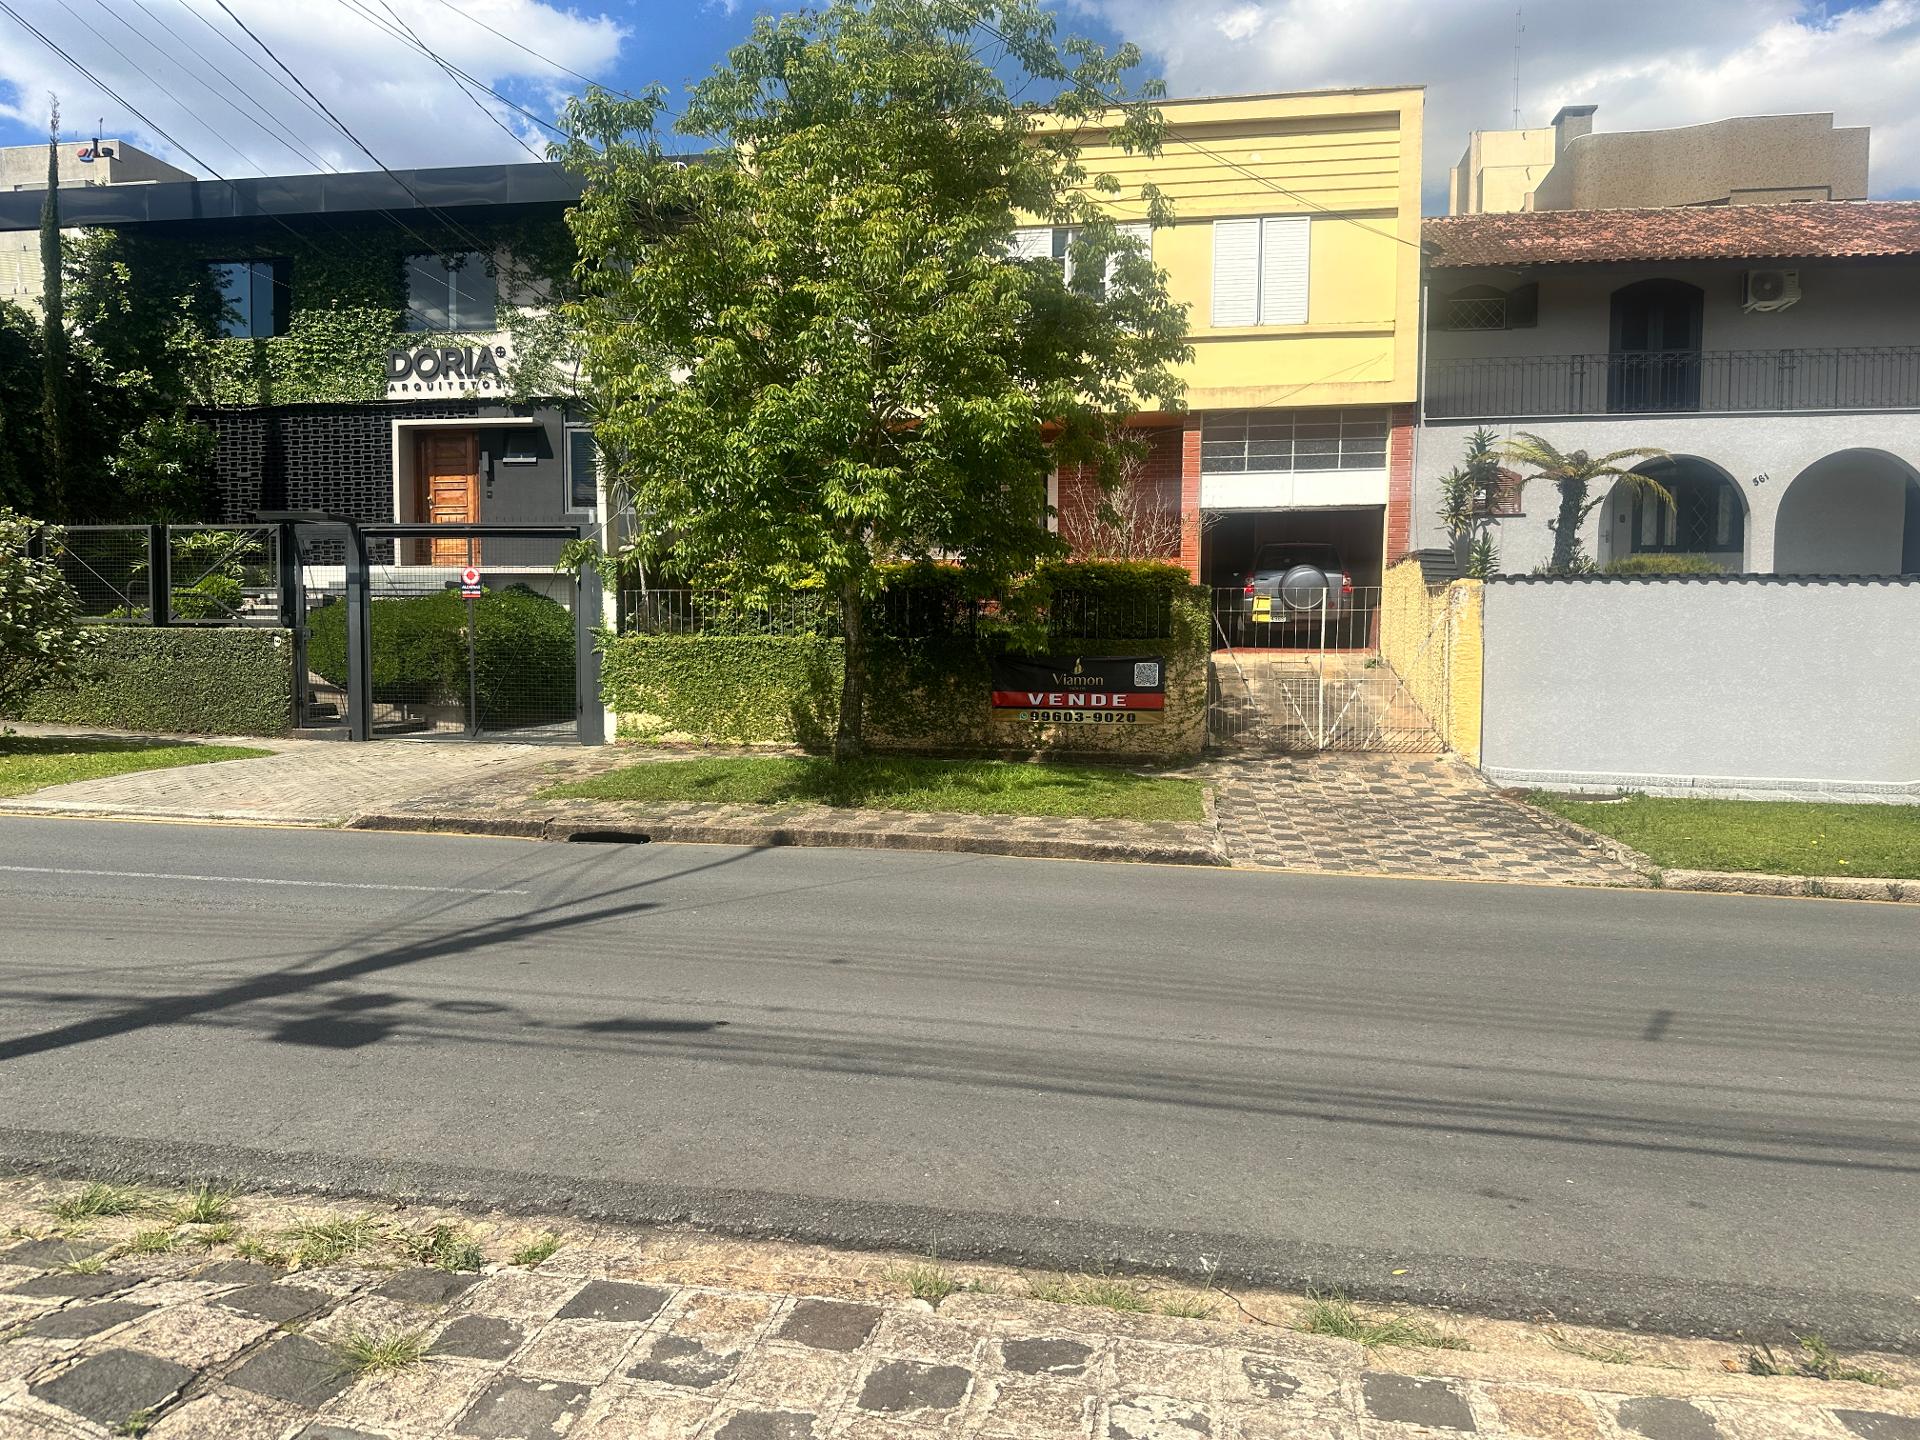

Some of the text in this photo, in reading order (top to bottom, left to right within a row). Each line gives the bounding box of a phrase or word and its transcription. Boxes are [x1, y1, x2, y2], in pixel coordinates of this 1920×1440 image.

[387, 346, 501, 382] DORIA
[389, 380, 502, 393] ARQUITETOS
[1052, 673, 1104, 687] Viamon
[1027, 692, 1127, 707] VENDE
[1030, 711, 1136, 723] 99603-9020
